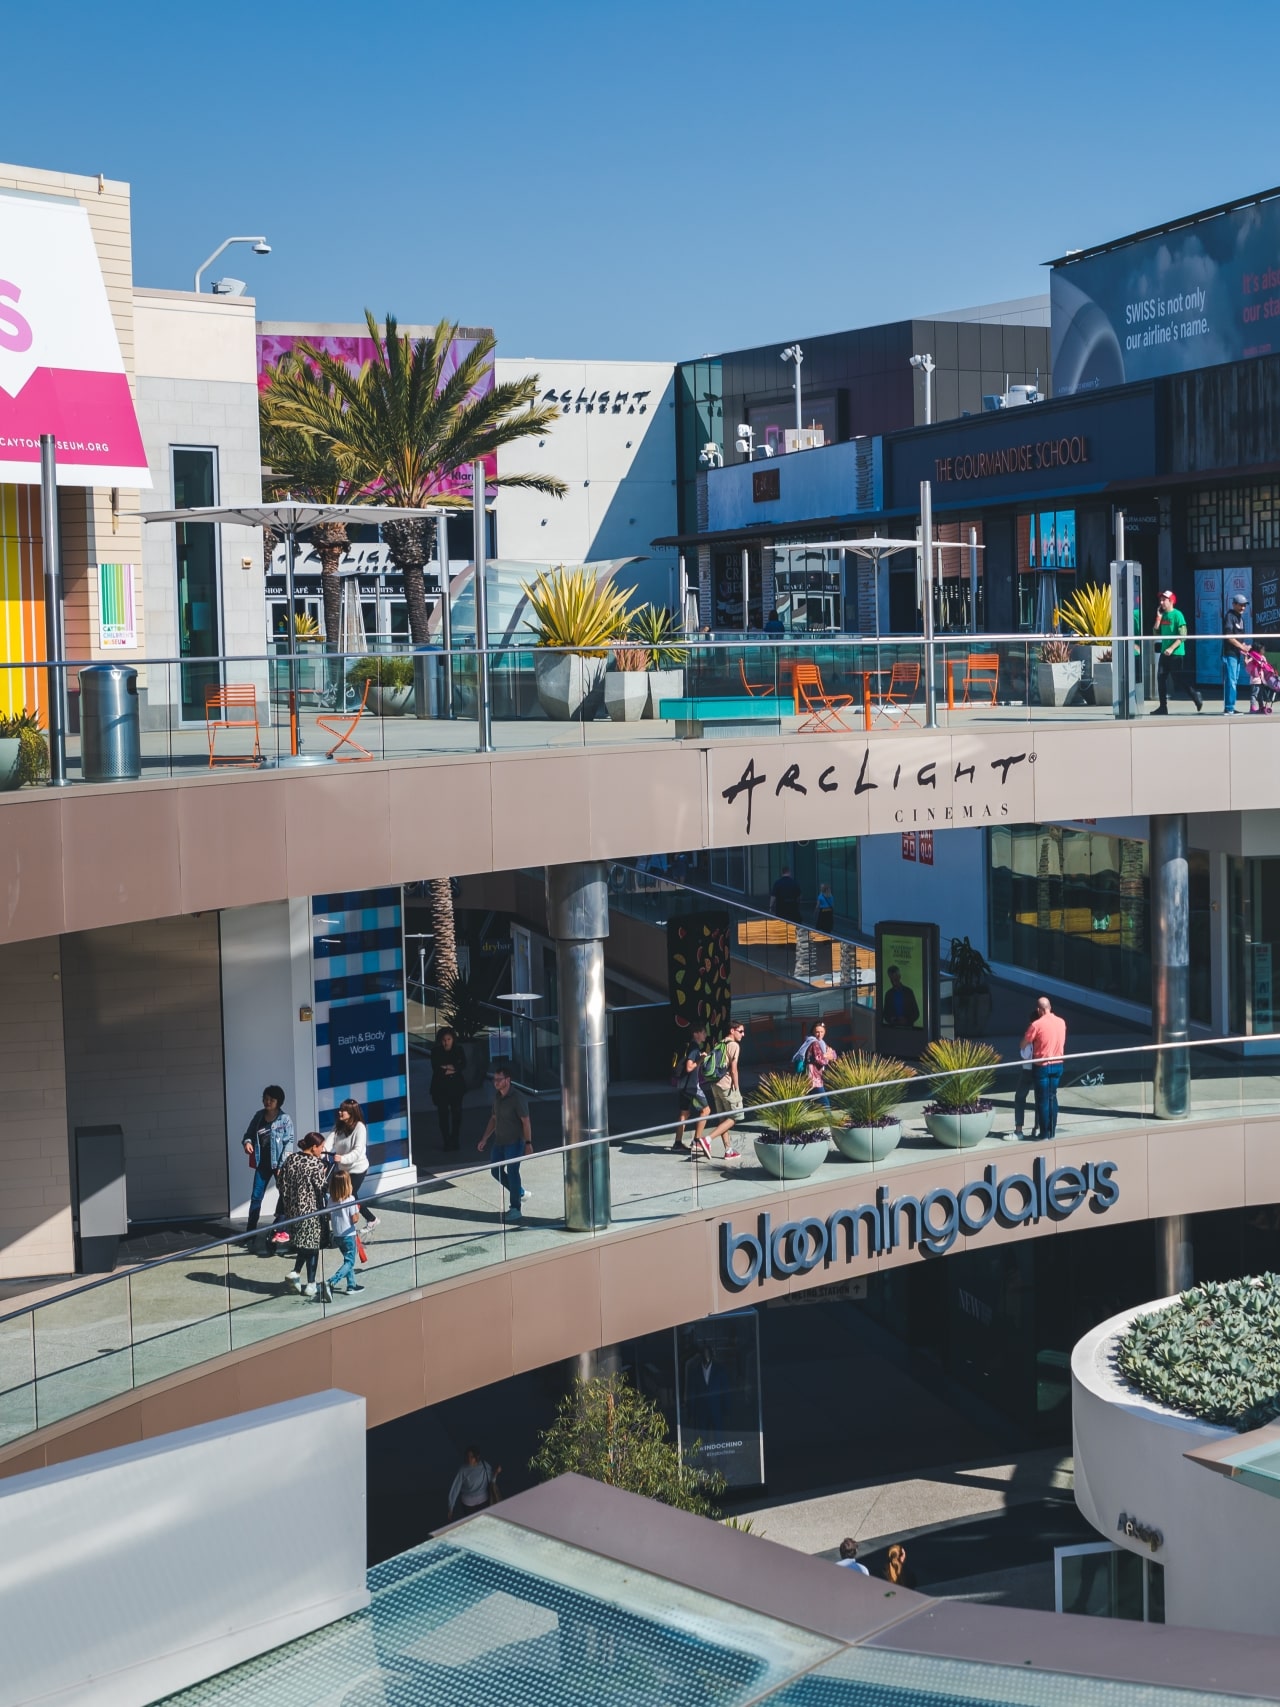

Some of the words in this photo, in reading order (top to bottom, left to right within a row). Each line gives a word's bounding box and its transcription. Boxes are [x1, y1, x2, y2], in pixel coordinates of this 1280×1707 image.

[1242, 273, 1260, 294] It's
[1125, 298, 1156, 325] SWISS
[1157, 297, 1166, 316] is
[1168, 294, 1184, 315] not
[1185, 286, 1206, 313] only
[1243, 304, 1262, 324] our
[1126, 332, 1142, 350] our
[1143, 321, 1179, 347] airline's
[1180, 317, 1210, 339] name.
[562, 403, 647, 415] CINEMAS
[935, 457, 953, 483] THE
[954, 444, 1032, 481] GOURMANDISE
[1035, 435, 1088, 469] SCHOOL
[293, 585, 309, 594] AFÉ
[895, 803, 1019, 824] CINEMAS
[482, 940, 512, 953] drybar
[337, 1035, 357, 1046] Bath
[357, 1033, 364, 1042] &
[364, 1030, 386, 1041] Body
[350, 1043, 376, 1055] Works
[722, 1156, 1120, 1291] bloomingdale's
[704, 1440, 743, 1452] INDOCHINO
